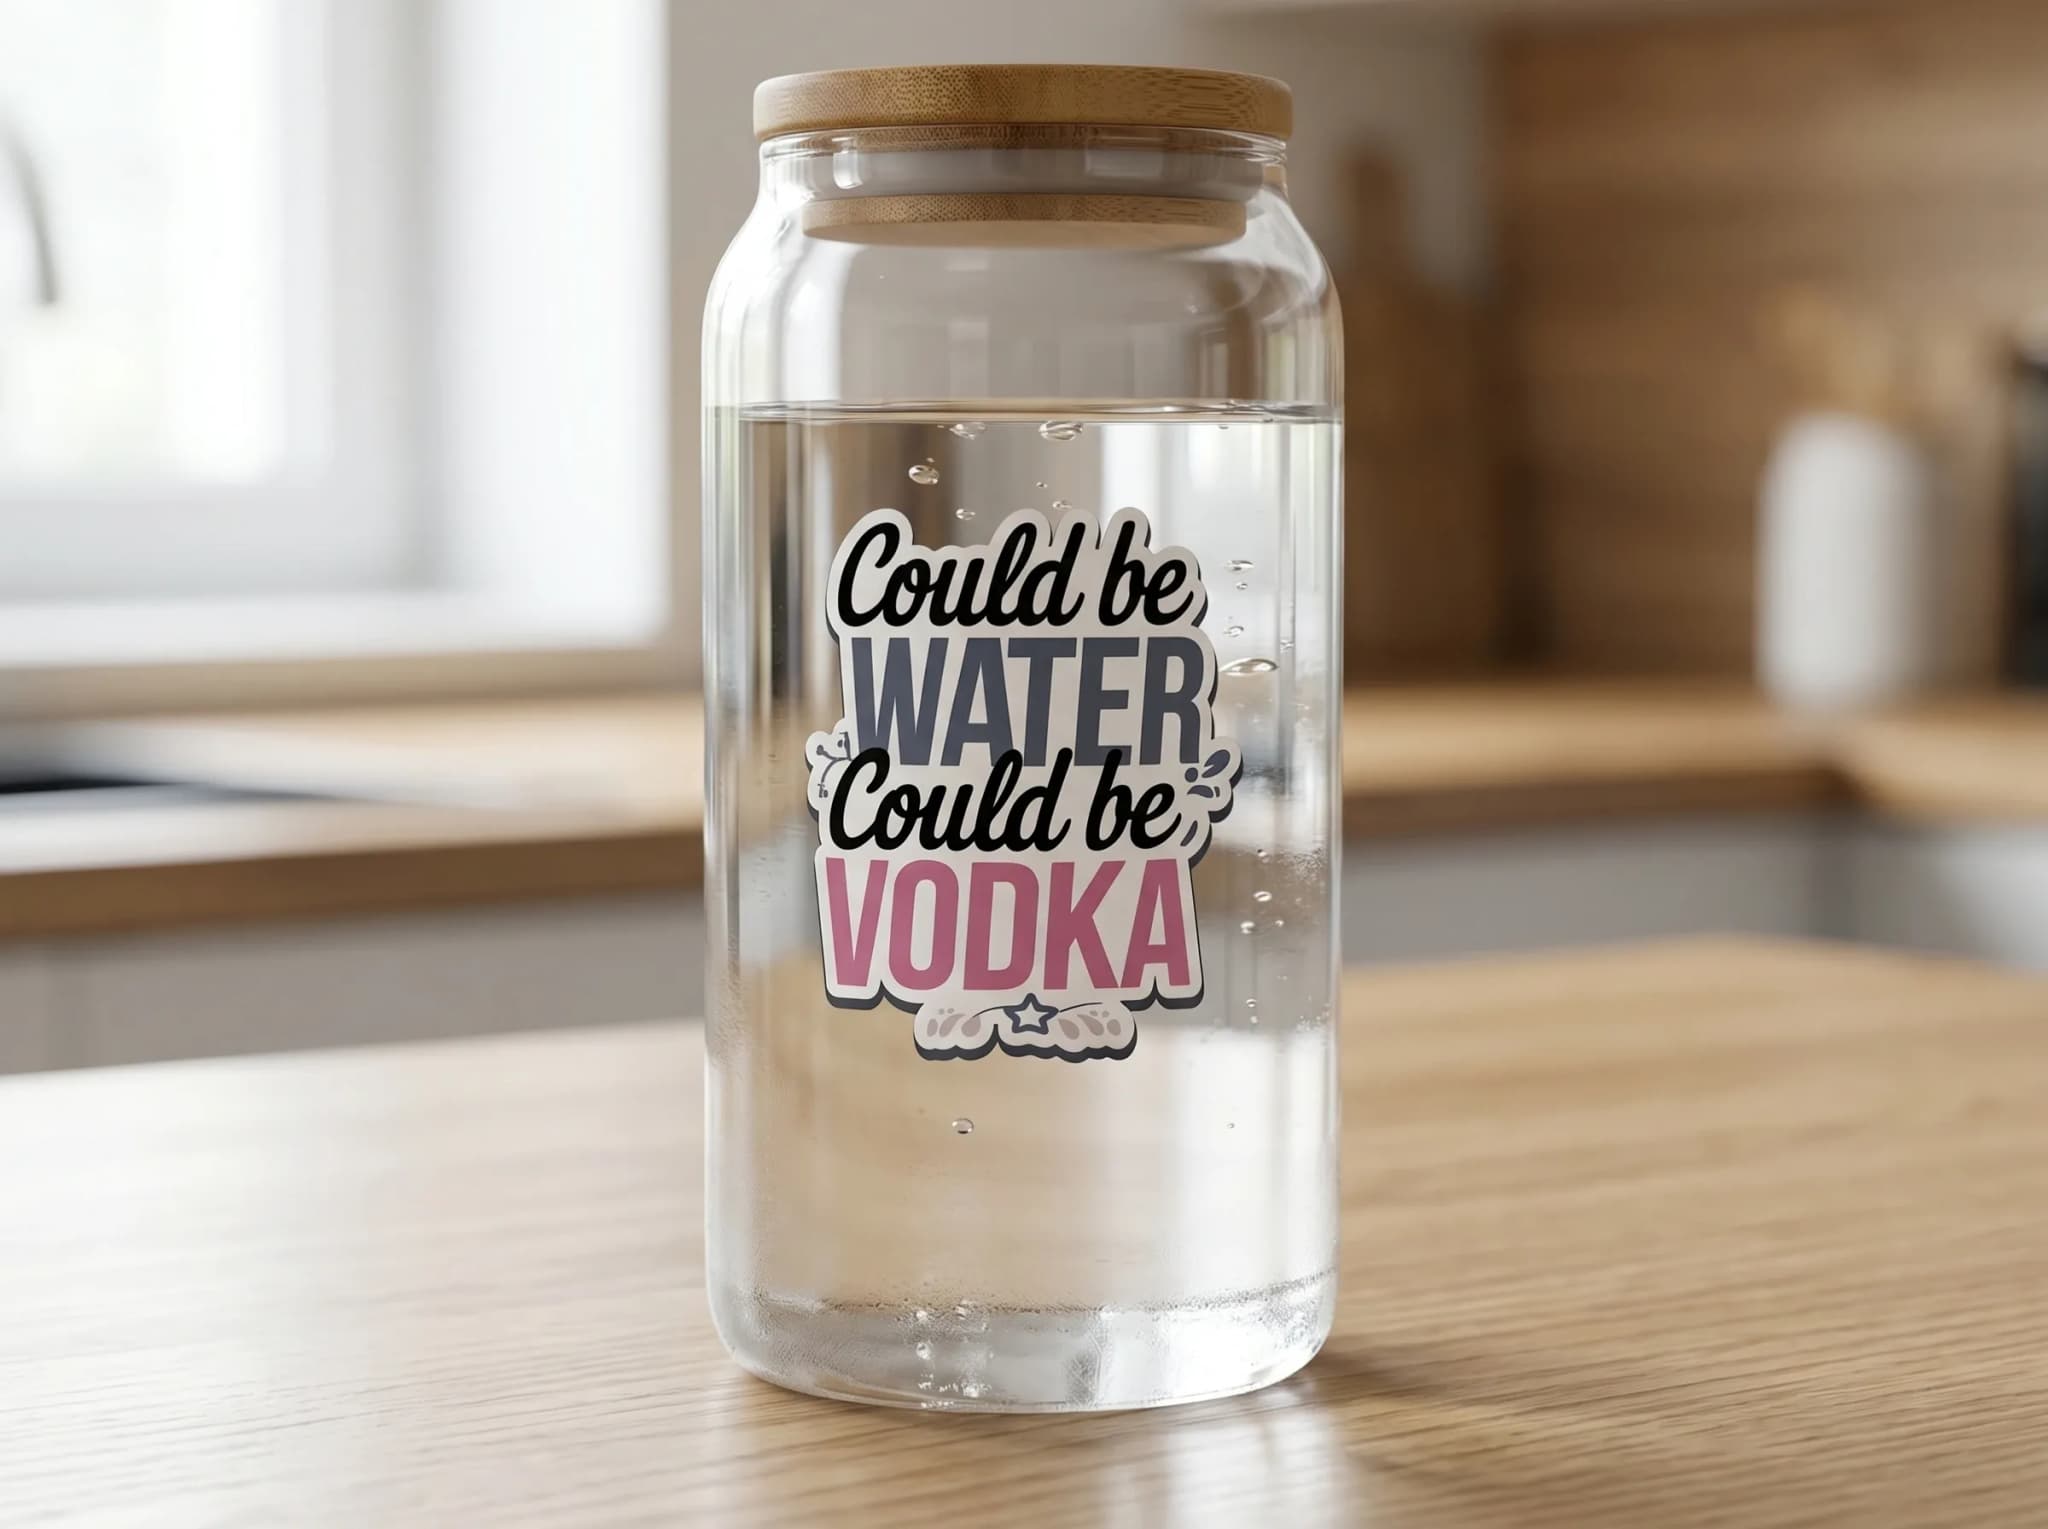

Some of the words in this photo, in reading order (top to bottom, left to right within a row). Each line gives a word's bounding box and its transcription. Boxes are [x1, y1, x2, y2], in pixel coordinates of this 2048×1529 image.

[837, 522, 1085, 627] Could
[1098, 520, 1194, 626] be
[851, 636, 1204, 766] WATER
[829, 747, 1073, 852] Could
[1085, 748, 1182, 851] be
[826, 857, 1190, 990] VODKA
